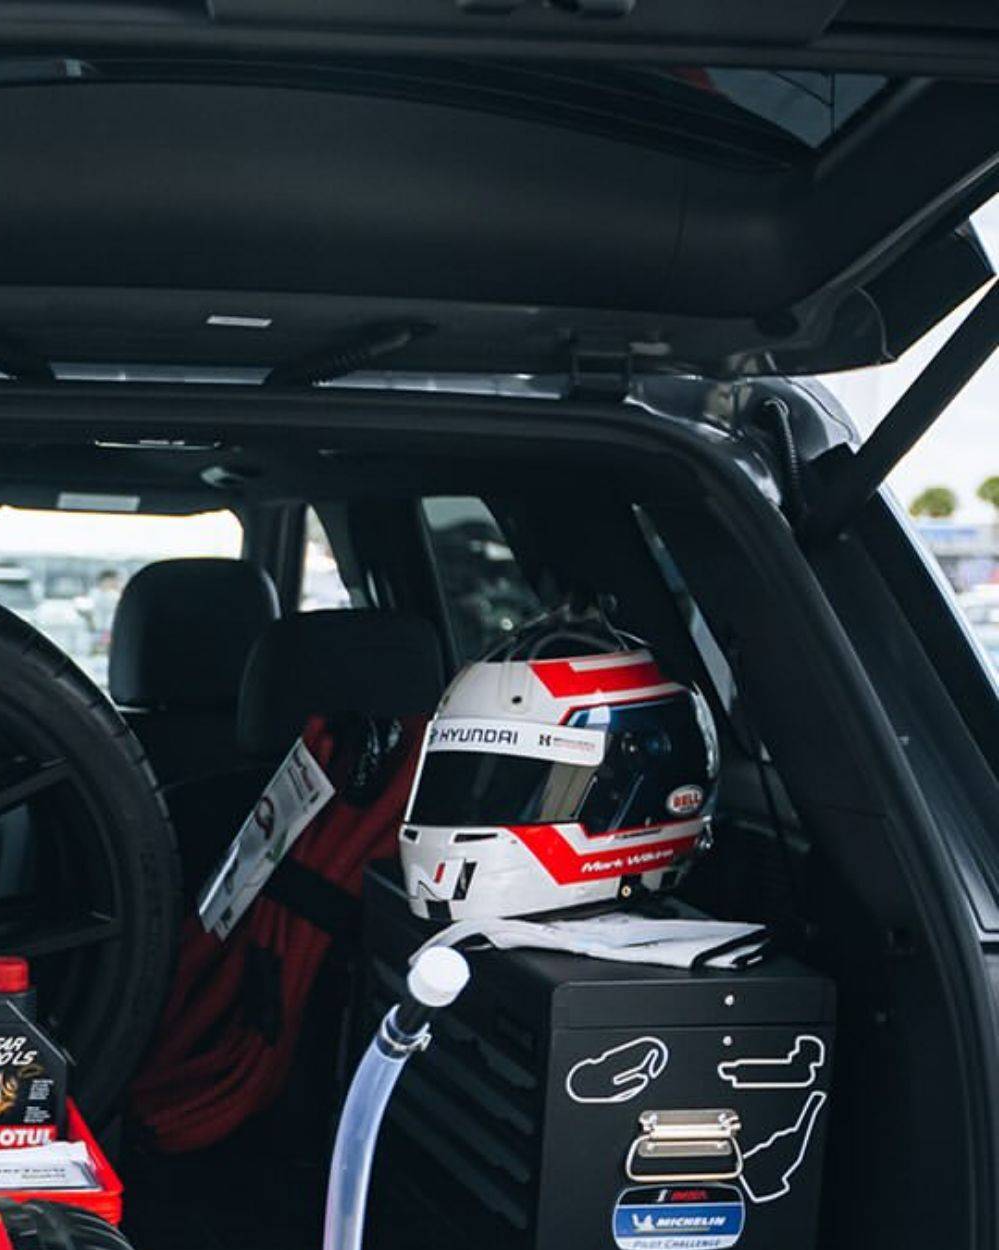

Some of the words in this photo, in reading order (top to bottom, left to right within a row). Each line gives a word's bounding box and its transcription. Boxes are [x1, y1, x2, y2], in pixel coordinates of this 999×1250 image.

[439, 728, 519, 745] HYUNDAI
[581, 858, 622, 873] Mark
[656, 1216, 726, 1227] MICHELIN
